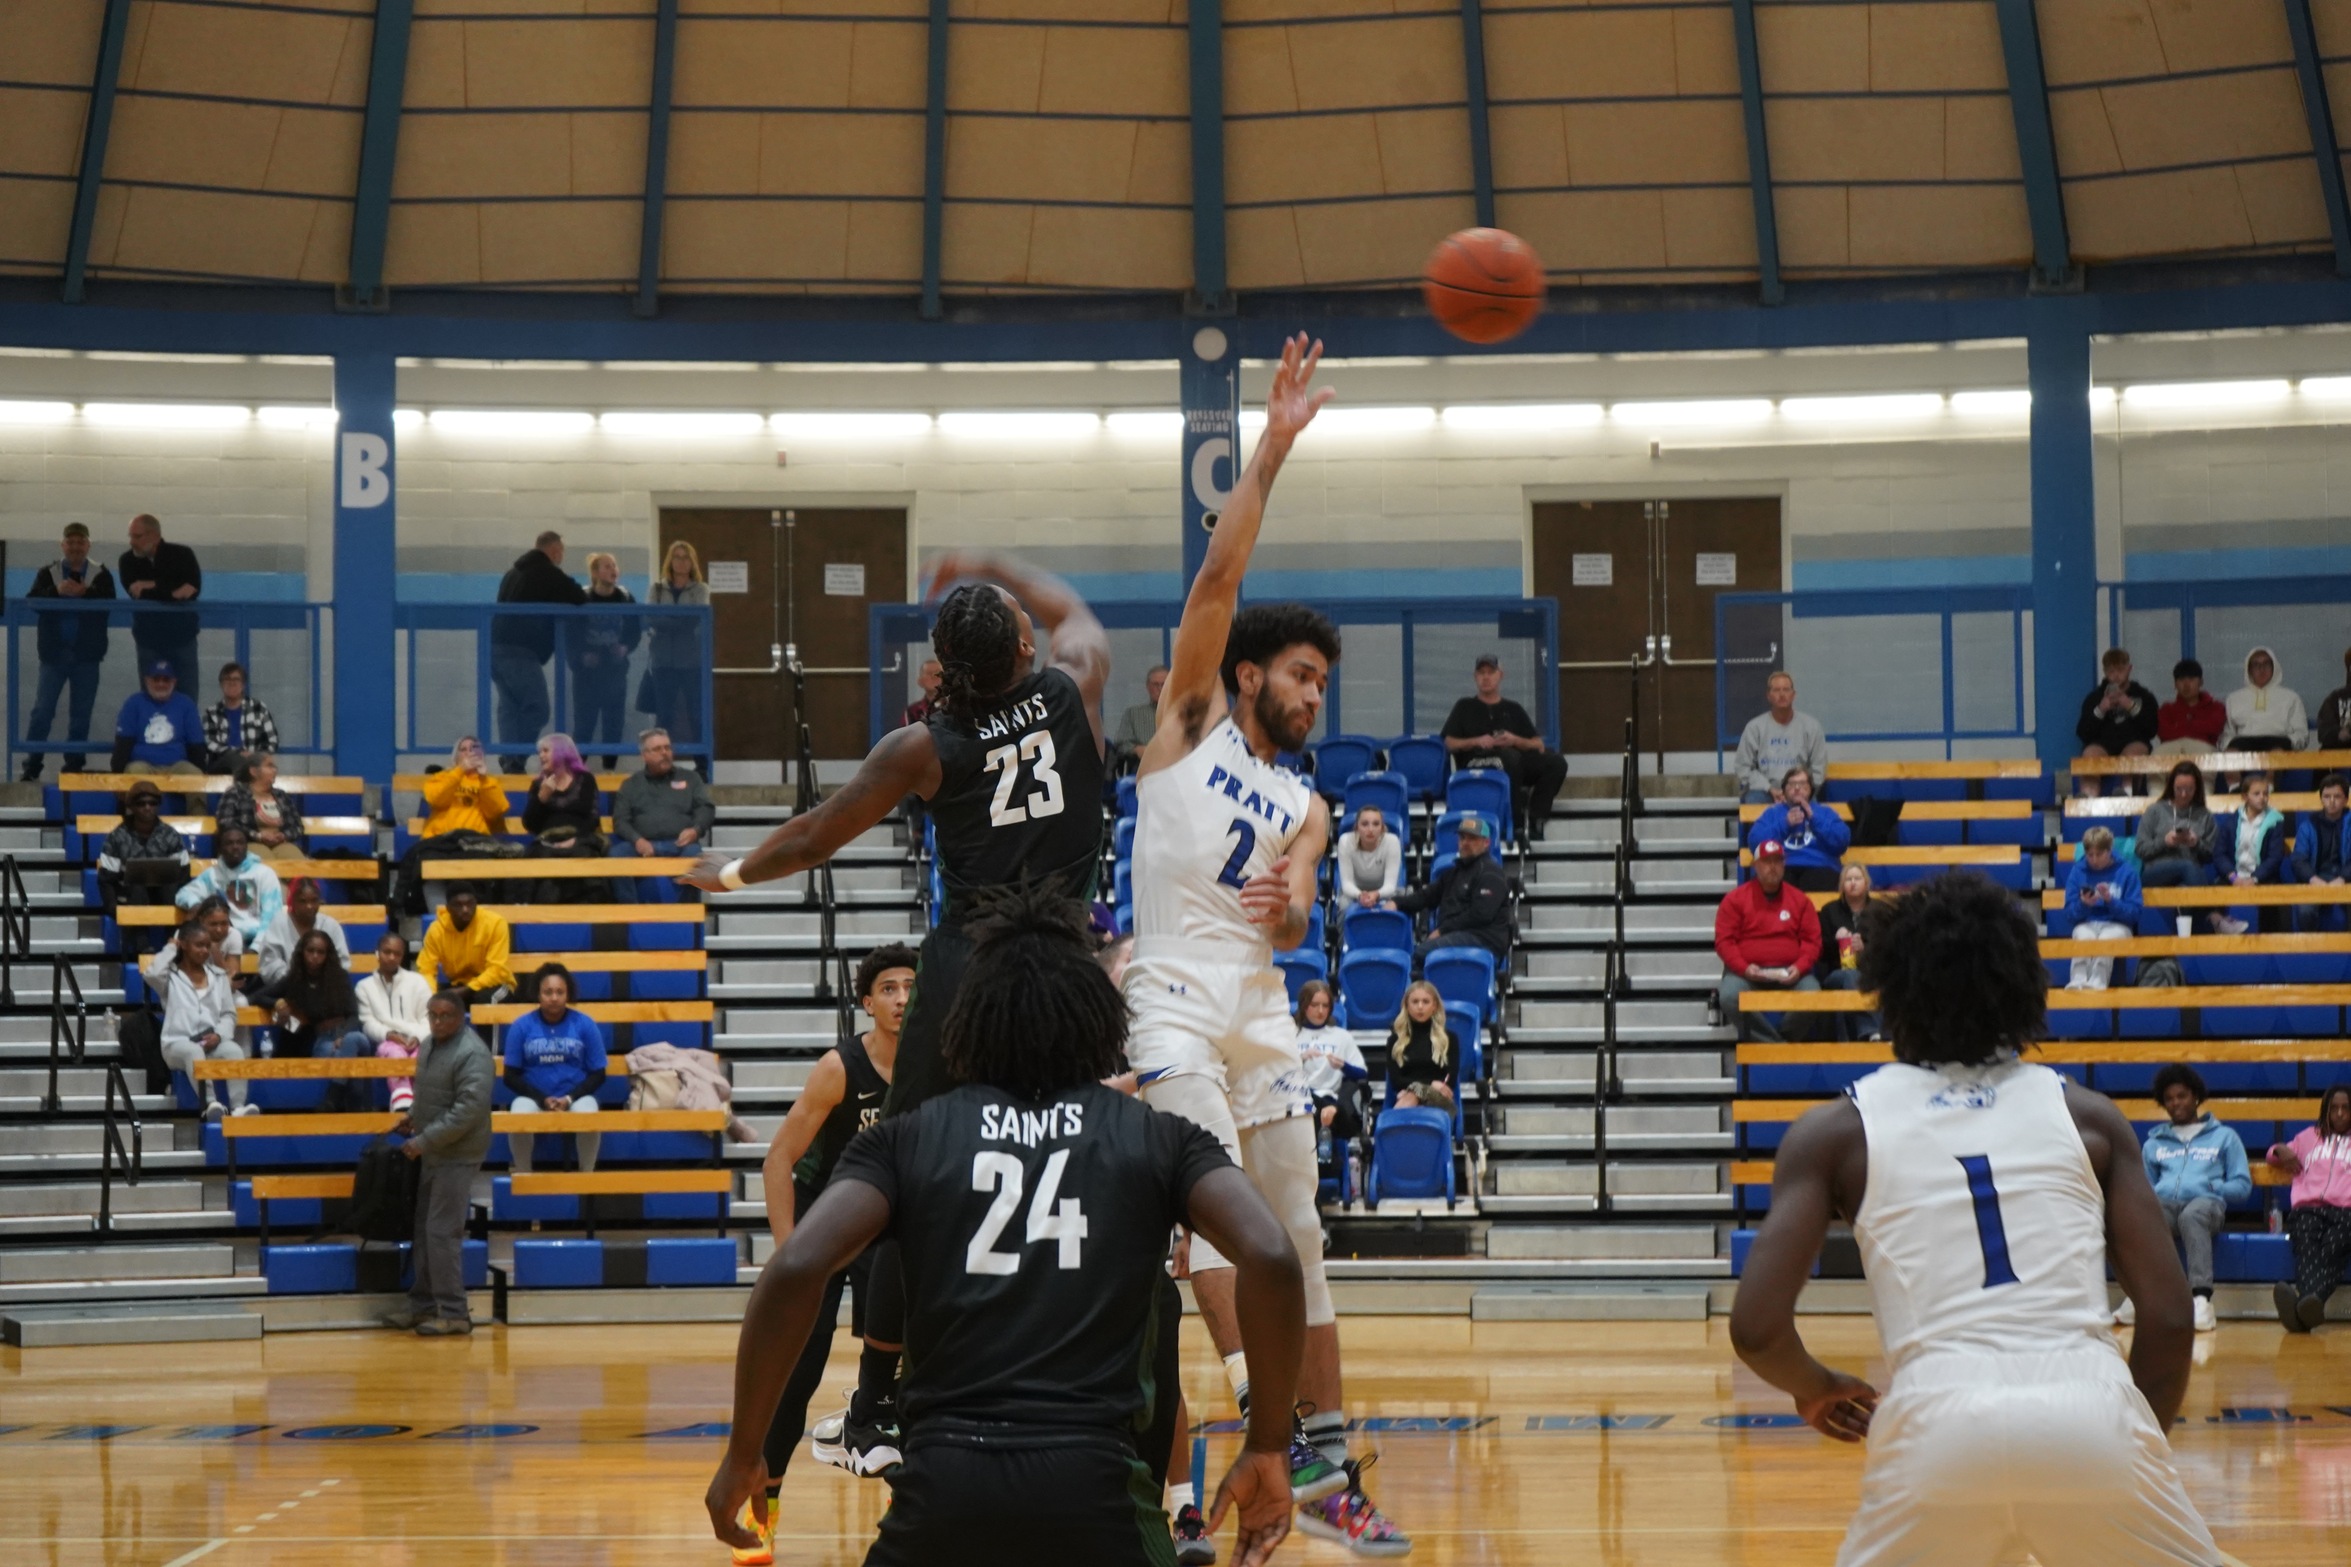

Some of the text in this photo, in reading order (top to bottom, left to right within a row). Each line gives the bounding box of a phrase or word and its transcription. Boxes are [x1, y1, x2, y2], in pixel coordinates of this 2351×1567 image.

[1190, 421, 1229, 433] SEATING
[341, 431, 390, 509] B
[1191, 437, 1233, 514] C
[975, 692, 1049, 740] SAINTS
[983, 729, 1064, 827] 23
[1206, 763, 1294, 835] PRATT
[1216, 817, 1256, 890] 2
[539, 1054, 565, 1063] MOM
[1298, 1043, 1338, 1054] RATT
[981, 1101, 1084, 1149] SAINTS
[966, 1148, 1088, 1276] 24
[1953, 1153, 2022, 1290] 1
